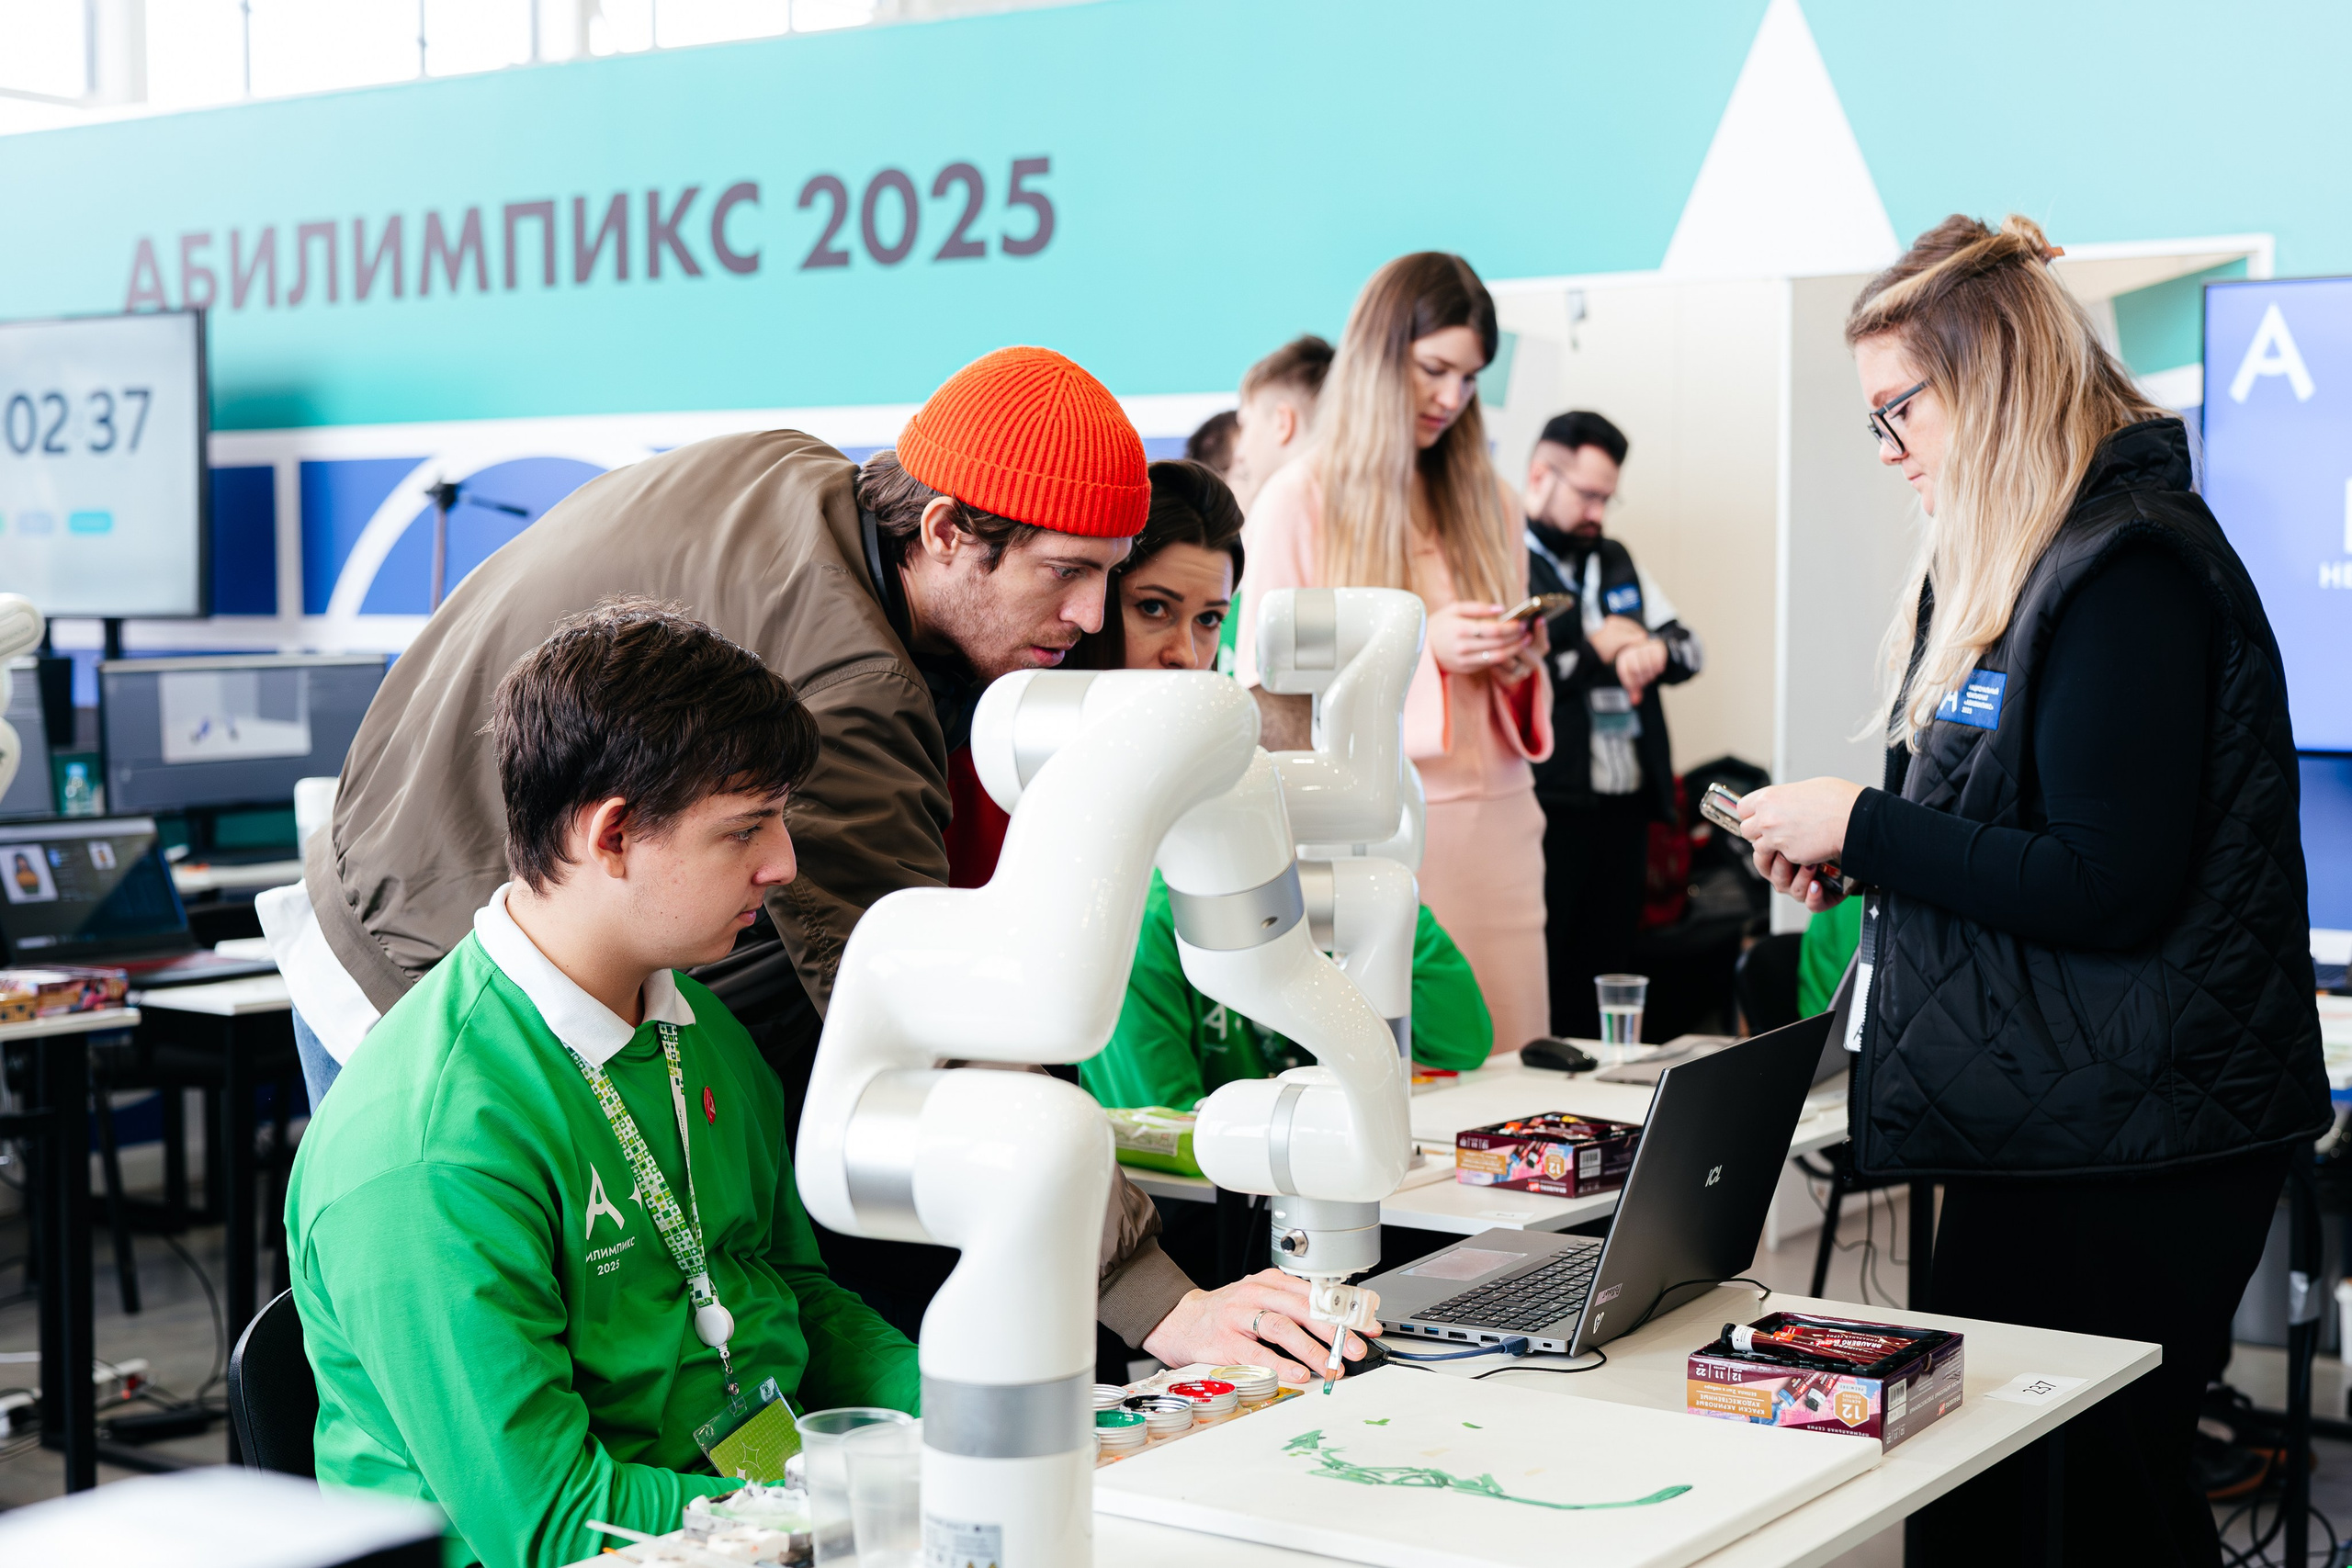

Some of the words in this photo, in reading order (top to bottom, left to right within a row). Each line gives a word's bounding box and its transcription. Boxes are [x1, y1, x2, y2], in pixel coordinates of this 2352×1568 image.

[124, 180, 761, 311] АБИЛИМПИКС
[797, 156, 1056, 271] 2025
[597, 1258, 620, 1276] 2025
[1841, 1339, 1883, 1349] BRAUBERG
[1696, 1367, 1706, 1376] 22
[1715, 1371, 1724, 1380] 11
[1732, 1372, 1742, 1382] 12
[1696, 1400, 1736, 1411] АКРИЛОВЫЕ
[1700, 1394, 1760, 1407] ХУДОЖЕСТВЕННЫЕ
[1738, 1406, 1765, 1416] КРАСКИ
[1842, 1404, 1861, 1420] 12
